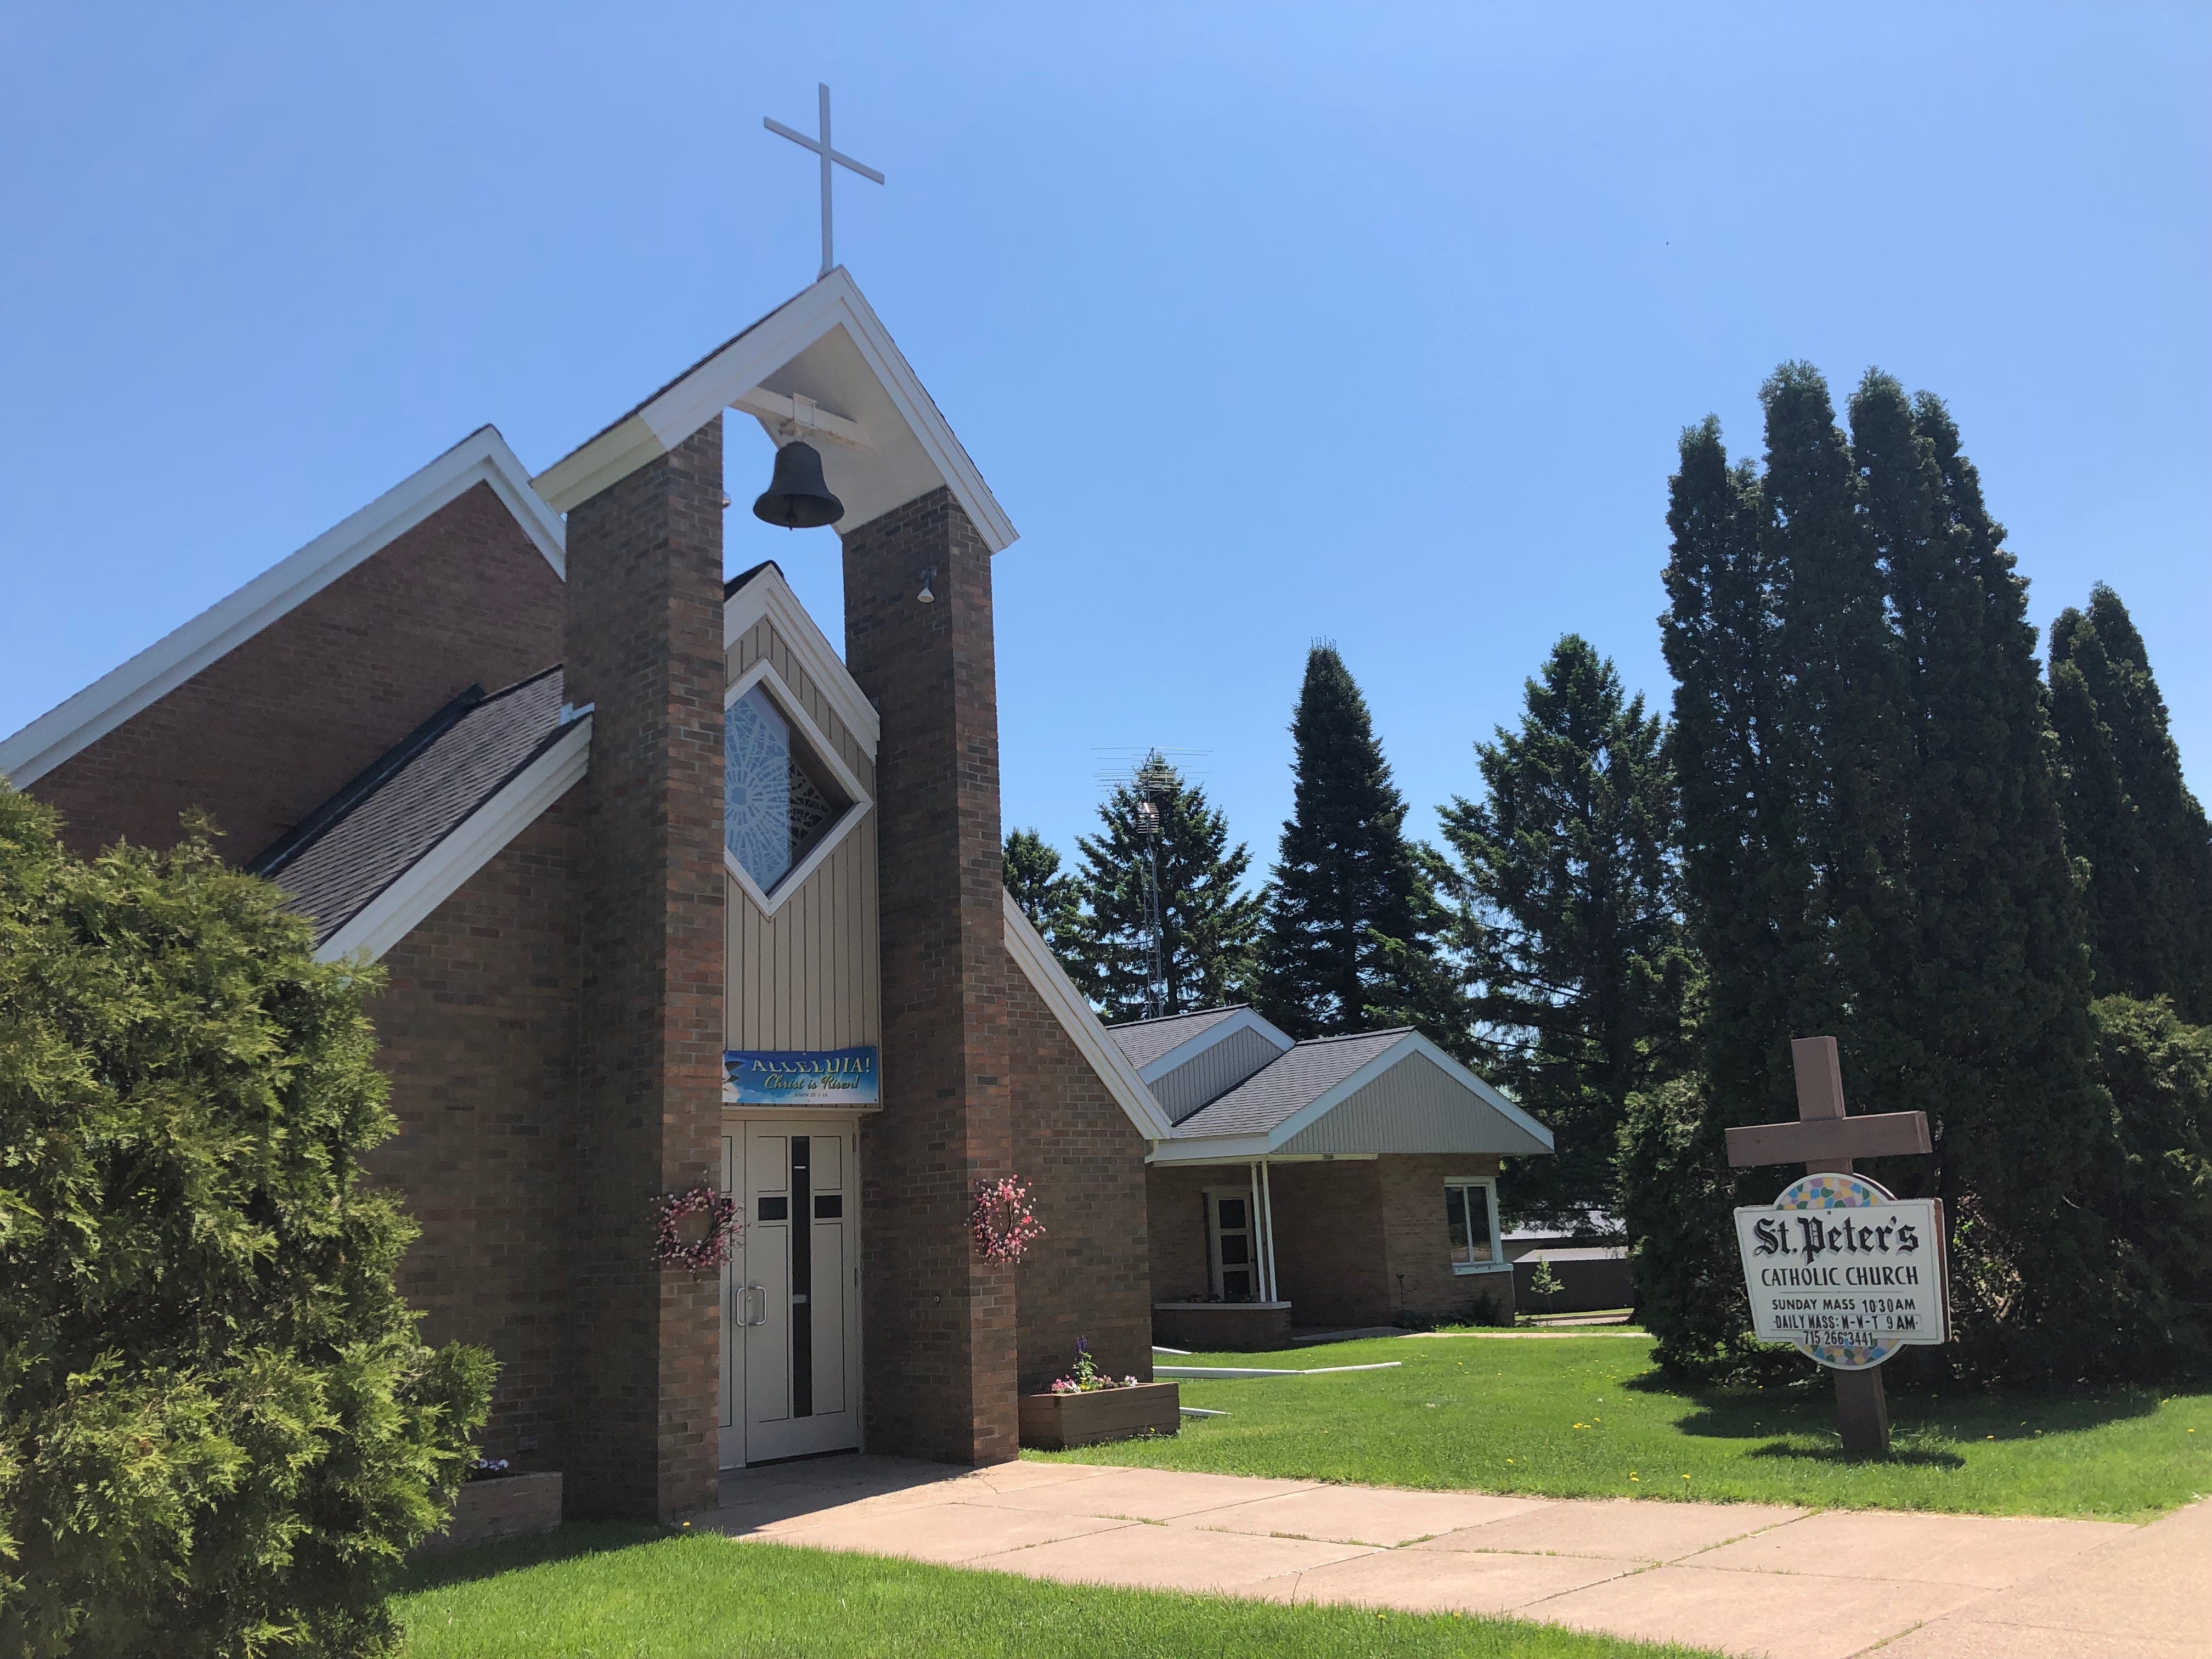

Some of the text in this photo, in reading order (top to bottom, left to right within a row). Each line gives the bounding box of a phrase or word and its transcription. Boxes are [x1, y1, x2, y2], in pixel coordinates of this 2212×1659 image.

[752, 1057, 871, 1073] ALLELUIA!
[764, 1074, 860, 1090] Christ is Risen!
[1761, 1266, 1919, 1286] CATHOLIC CHURCH
[1772, 1299, 1818, 1310] SUNDAY
[1823, 1299, 1855, 1310] MASS
[1775, 1314, 1804, 1329] DAILY
[1808, 1314, 1839, 1329] MASS:
[1803, 1330, 1821, 1344] 715
